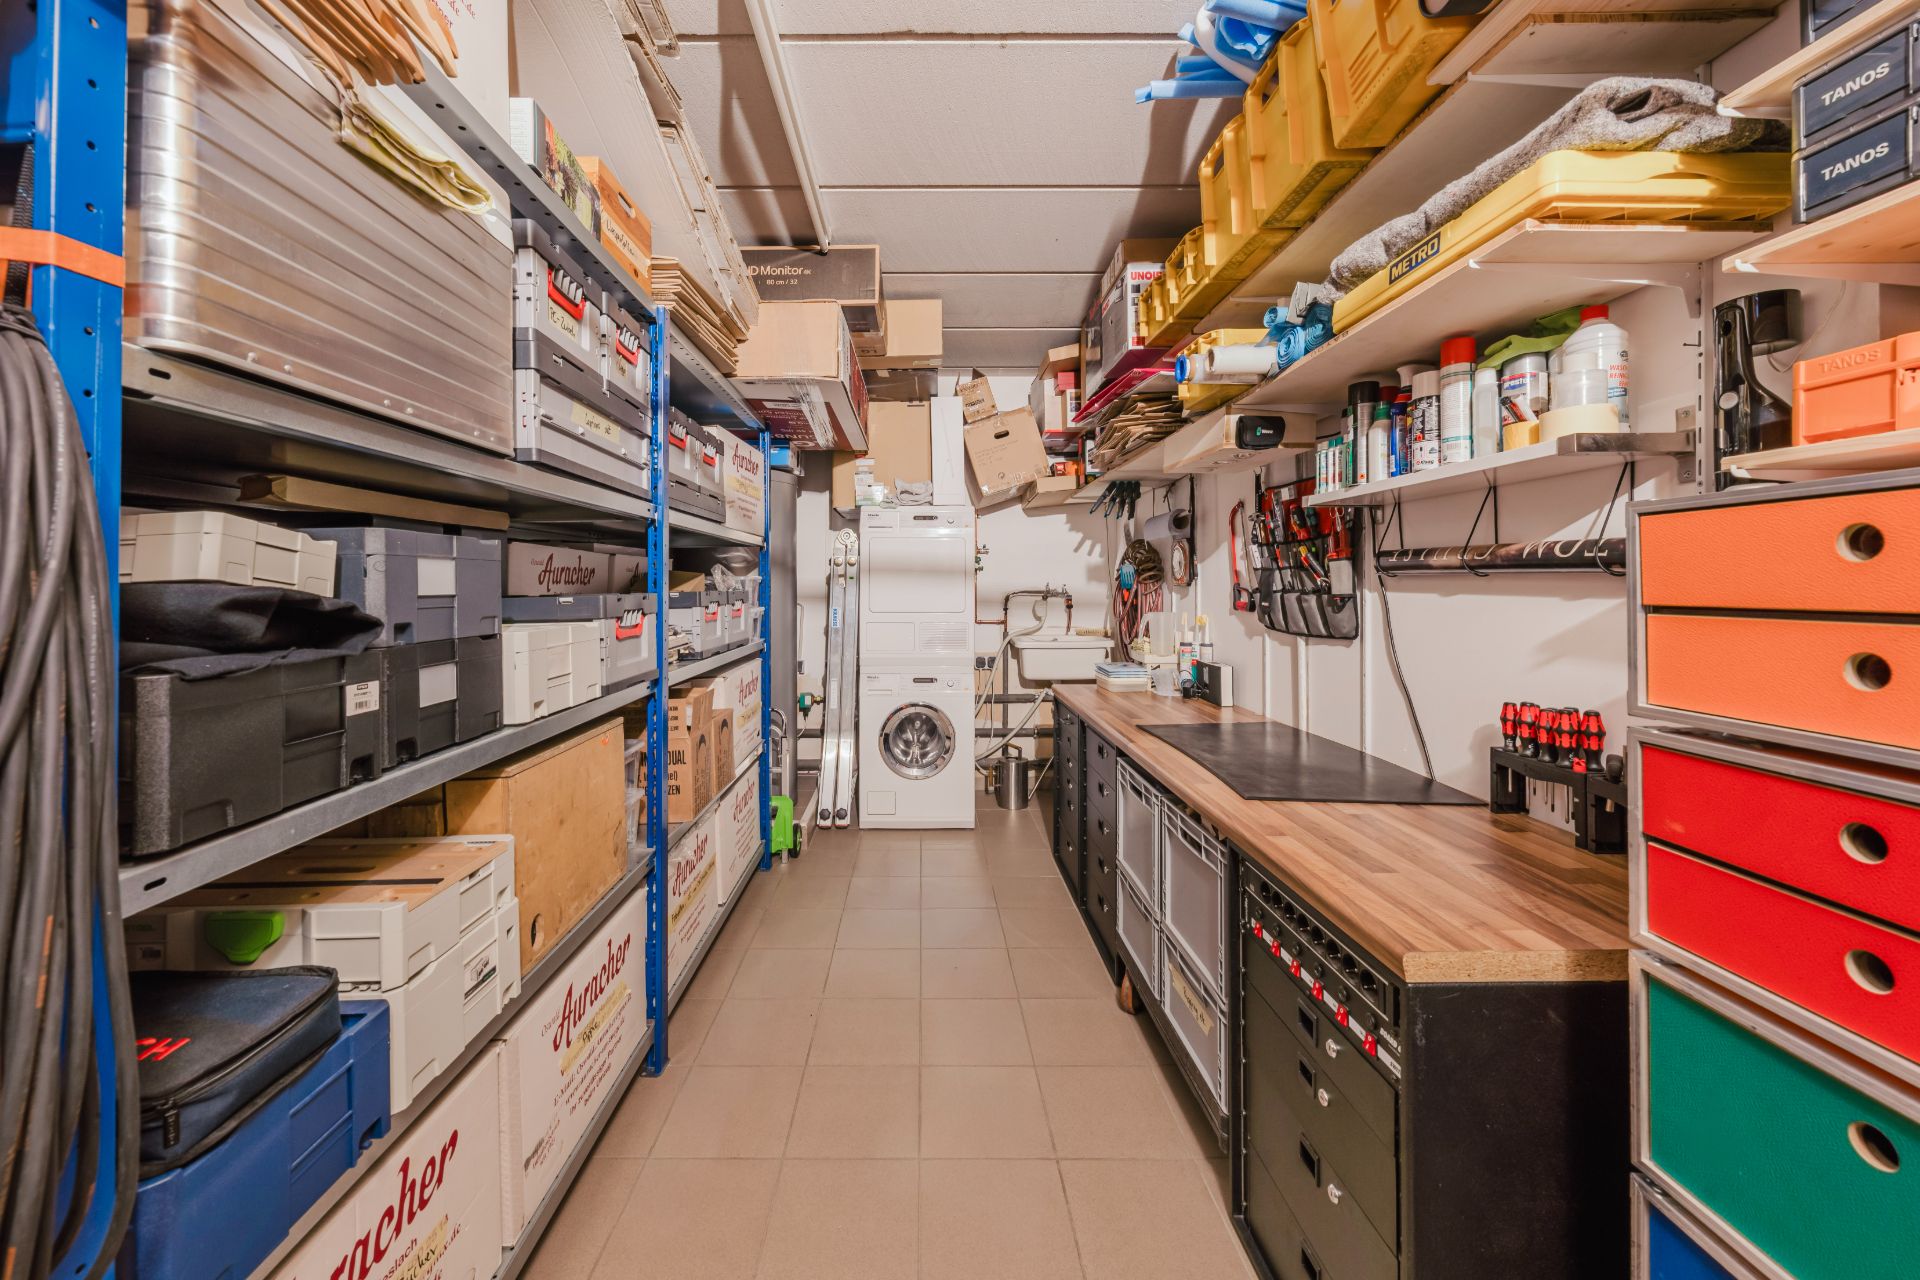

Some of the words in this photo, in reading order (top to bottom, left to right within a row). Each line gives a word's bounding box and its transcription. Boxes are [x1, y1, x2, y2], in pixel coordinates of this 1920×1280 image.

[1821, 62, 1890, 106] TANOS
[1821, 142, 1890, 181] TANOS
[760, 265, 804, 276] Monitor
[1391, 237, 1438, 281] METRO
[1819, 348, 1881, 374] TANOS
[732, 442, 759, 476] Auracher
[538, 552, 596, 593] Auracher
[672, 833, 708, 898] Auracher
[552, 933, 631, 1052] Auracher
